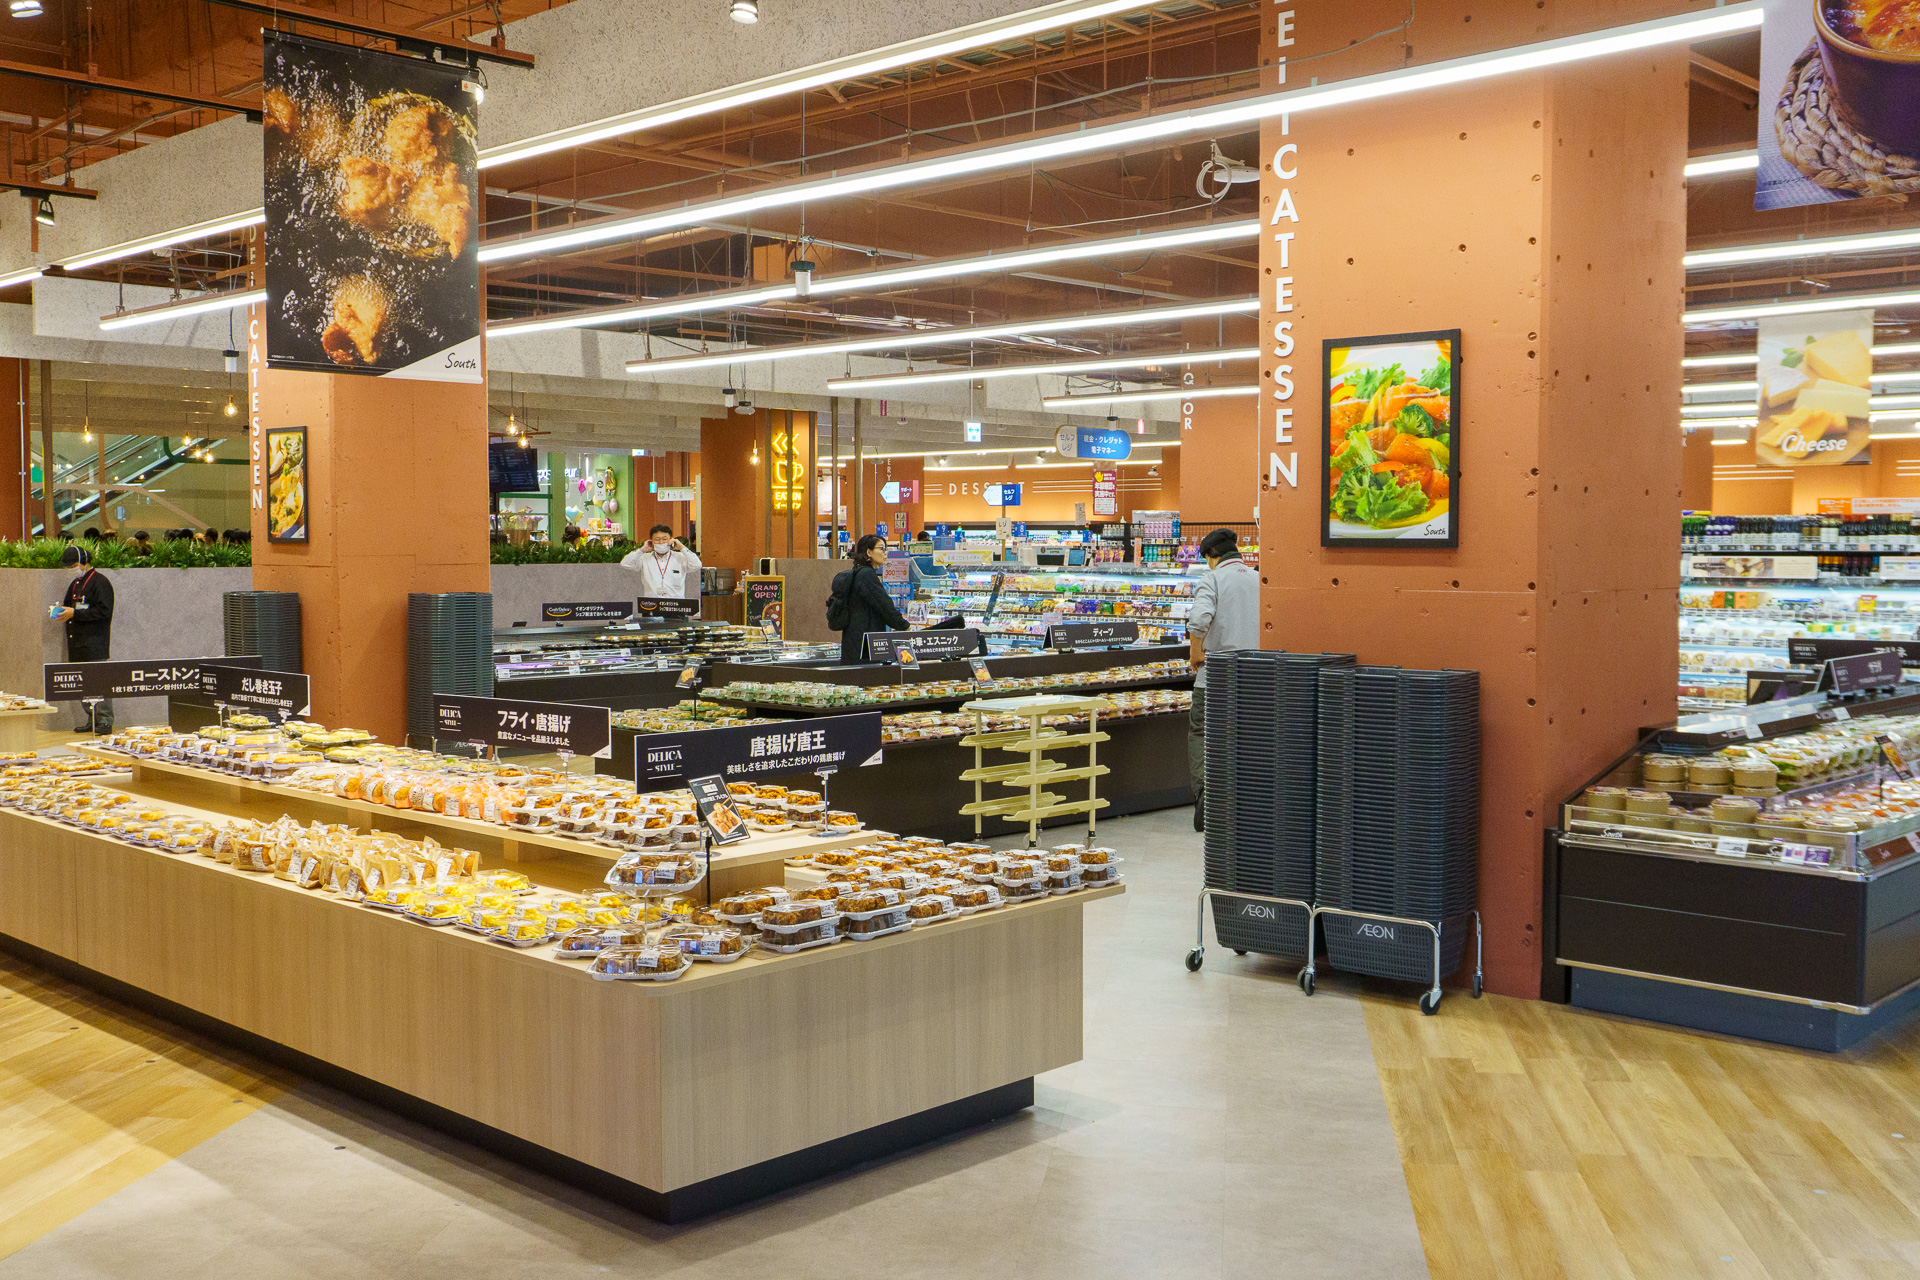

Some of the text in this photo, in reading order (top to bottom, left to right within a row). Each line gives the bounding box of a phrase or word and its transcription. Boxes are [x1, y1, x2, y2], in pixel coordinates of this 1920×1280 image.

[445, 352, 477, 369] South
[1059, 433, 1075, 441] セルフ
[1083, 435, 1124, 445] 現金・クレジット
[1061, 443, 1073, 452] レジ
[1781, 434, 1848, 452] Cheese
[1091, 445, 1117, 454] 電子マネー
[881, 525, 888, 533] 10
[1423, 524, 1446, 536] South
[752, 583, 778, 591] GRAND
[754, 591, 777, 599] OPEN
[1092, 627, 1114, 637] ディーツ
[909, 635, 959, 647] 中華・エスニック
[54, 674, 83, 683] DELICA
[241, 677, 283, 696] だし巻き玉子
[439, 708, 462, 719] DELICA
[497, 710, 572, 734] フライ・唐揚げ
[497, 730, 570, 747] 豊富なメニューを品揃えしました
[749, 729, 827, 758] 唐揚げ唐王
[647, 750, 683, 763] DELICA
[654, 763, 675, 772] STYLE
[726, 750, 846, 775] 美味しさを追求したこだわりの鶏唐揚げ
